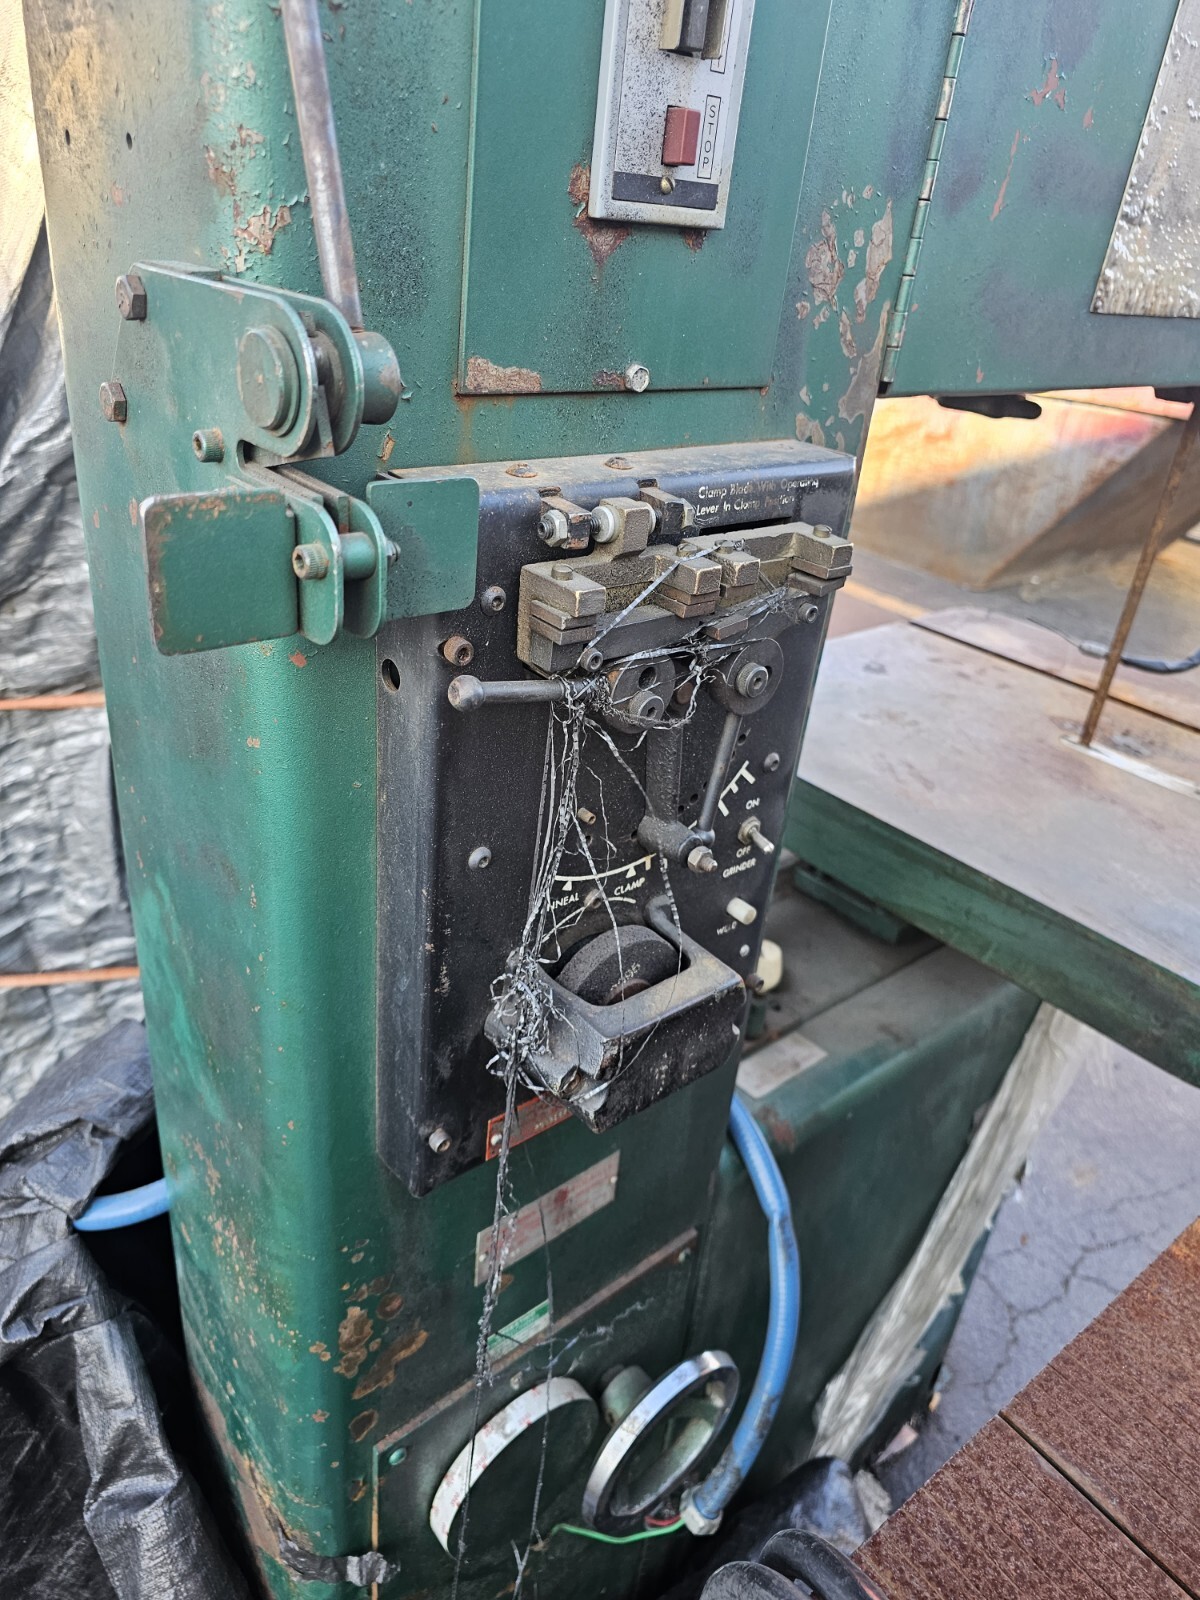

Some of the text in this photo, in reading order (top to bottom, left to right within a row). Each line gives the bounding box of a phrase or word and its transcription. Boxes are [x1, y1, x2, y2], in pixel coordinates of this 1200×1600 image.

[702, 105, 716, 169] STOP
[698, 485, 727, 499] Clamp
[696, 504, 719, 516] Lever
[723, 501, 731, 511] In
[745, 797, 760, 810] ON
[736, 845, 751, 858] OFF
[722, 857, 757, 878] GRINDER
[613, 877, 645, 896] CLAMP
[545, 892, 580, 912] NNEAL
